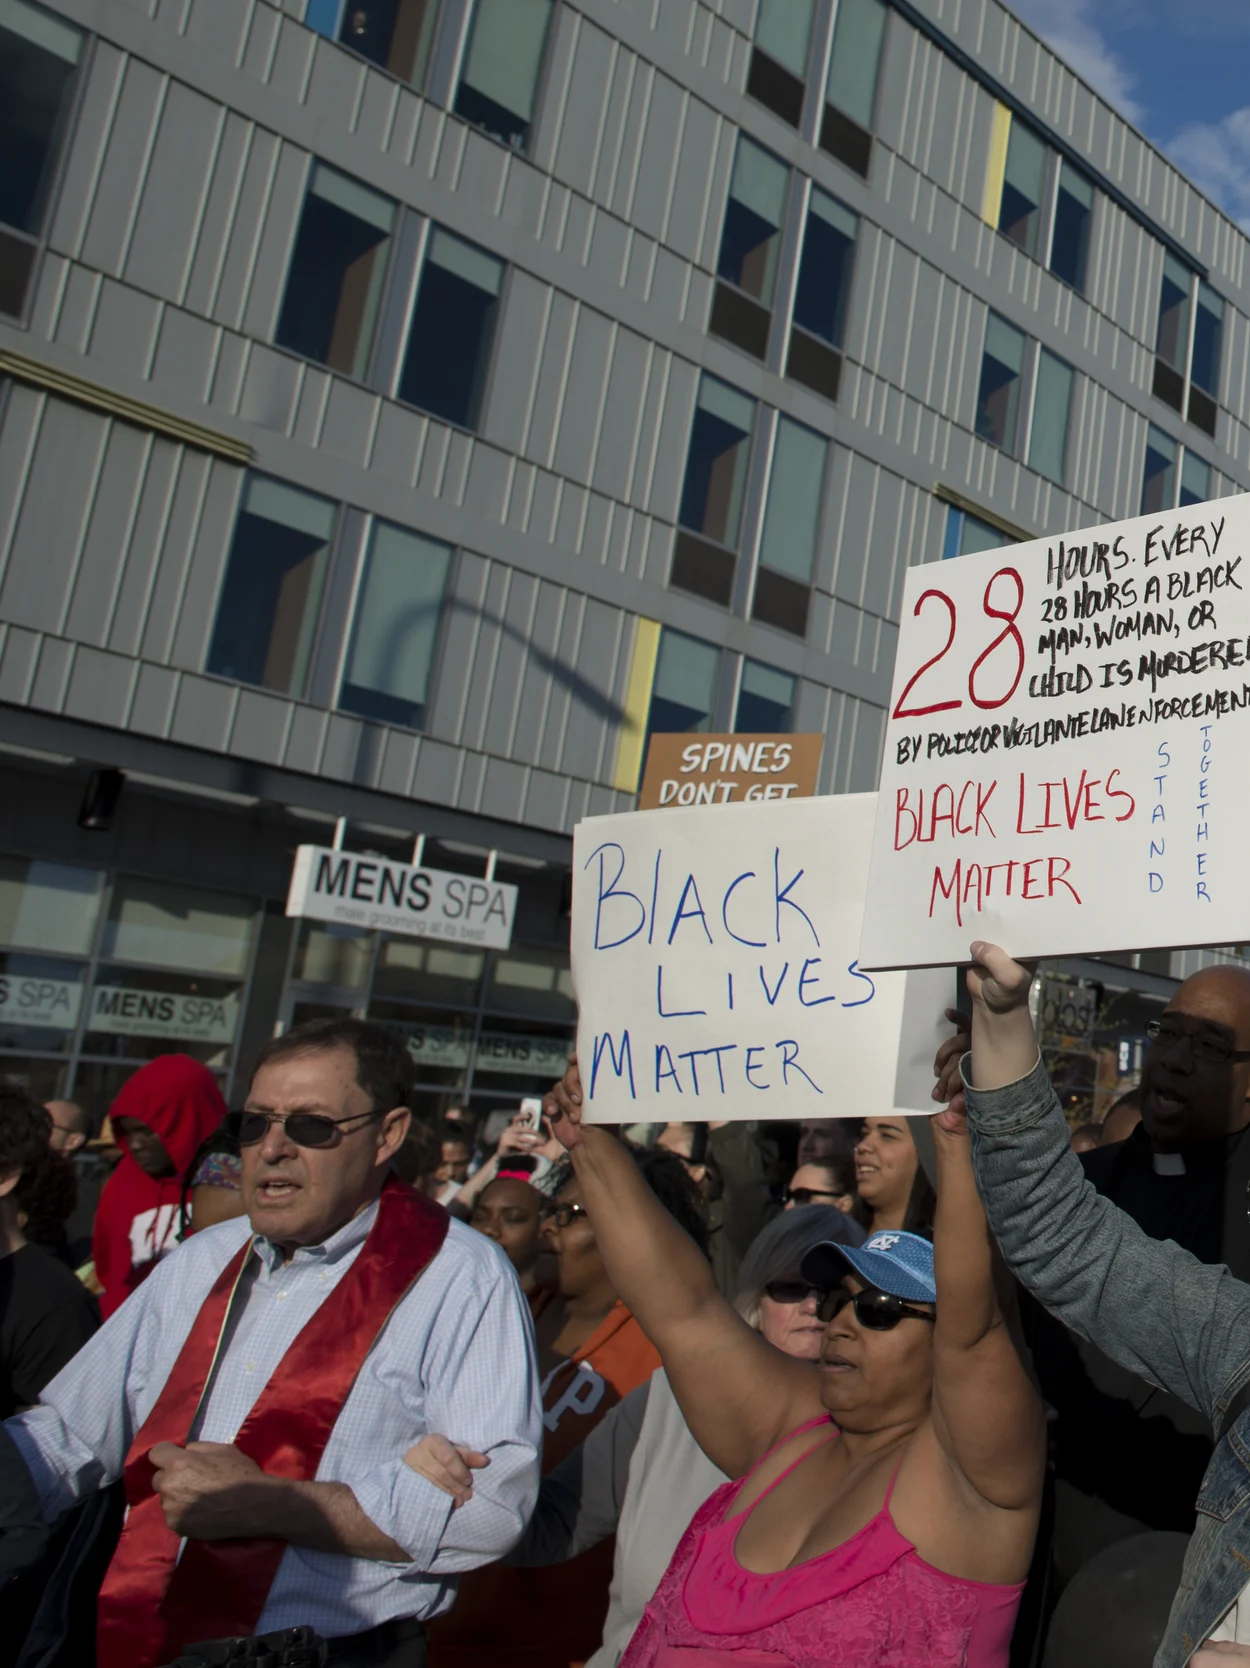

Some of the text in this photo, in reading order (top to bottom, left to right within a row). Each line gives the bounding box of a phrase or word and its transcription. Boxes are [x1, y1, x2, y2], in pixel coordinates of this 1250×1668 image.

[1047, 516, 1225, 591] HOURS. EVERY
[1041, 556, 1243, 623] 28 HOURS A BLACK
[892, 566, 1025, 719] 28
[1038, 600, 1217, 665] MAN, WOMAN, OR
[1029, 663, 1093, 697] CHILD
[1098, 659, 1133, 688] IS
[680, 742, 792, 773] SPINES
[896, 734, 922, 765] BY
[659, 779, 739, 806] DON'T
[894, 769, 1135, 851] BLACK LIVES
[314, 855, 508, 926] MENS SPA
[929, 857, 1082, 927] MATTER
[18, 981, 70, 1012] SPA
[96, 990, 227, 1028] MENS SPA
[658, 958, 876, 1018] LIVES
[590, 1029, 824, 1099] MATTER
